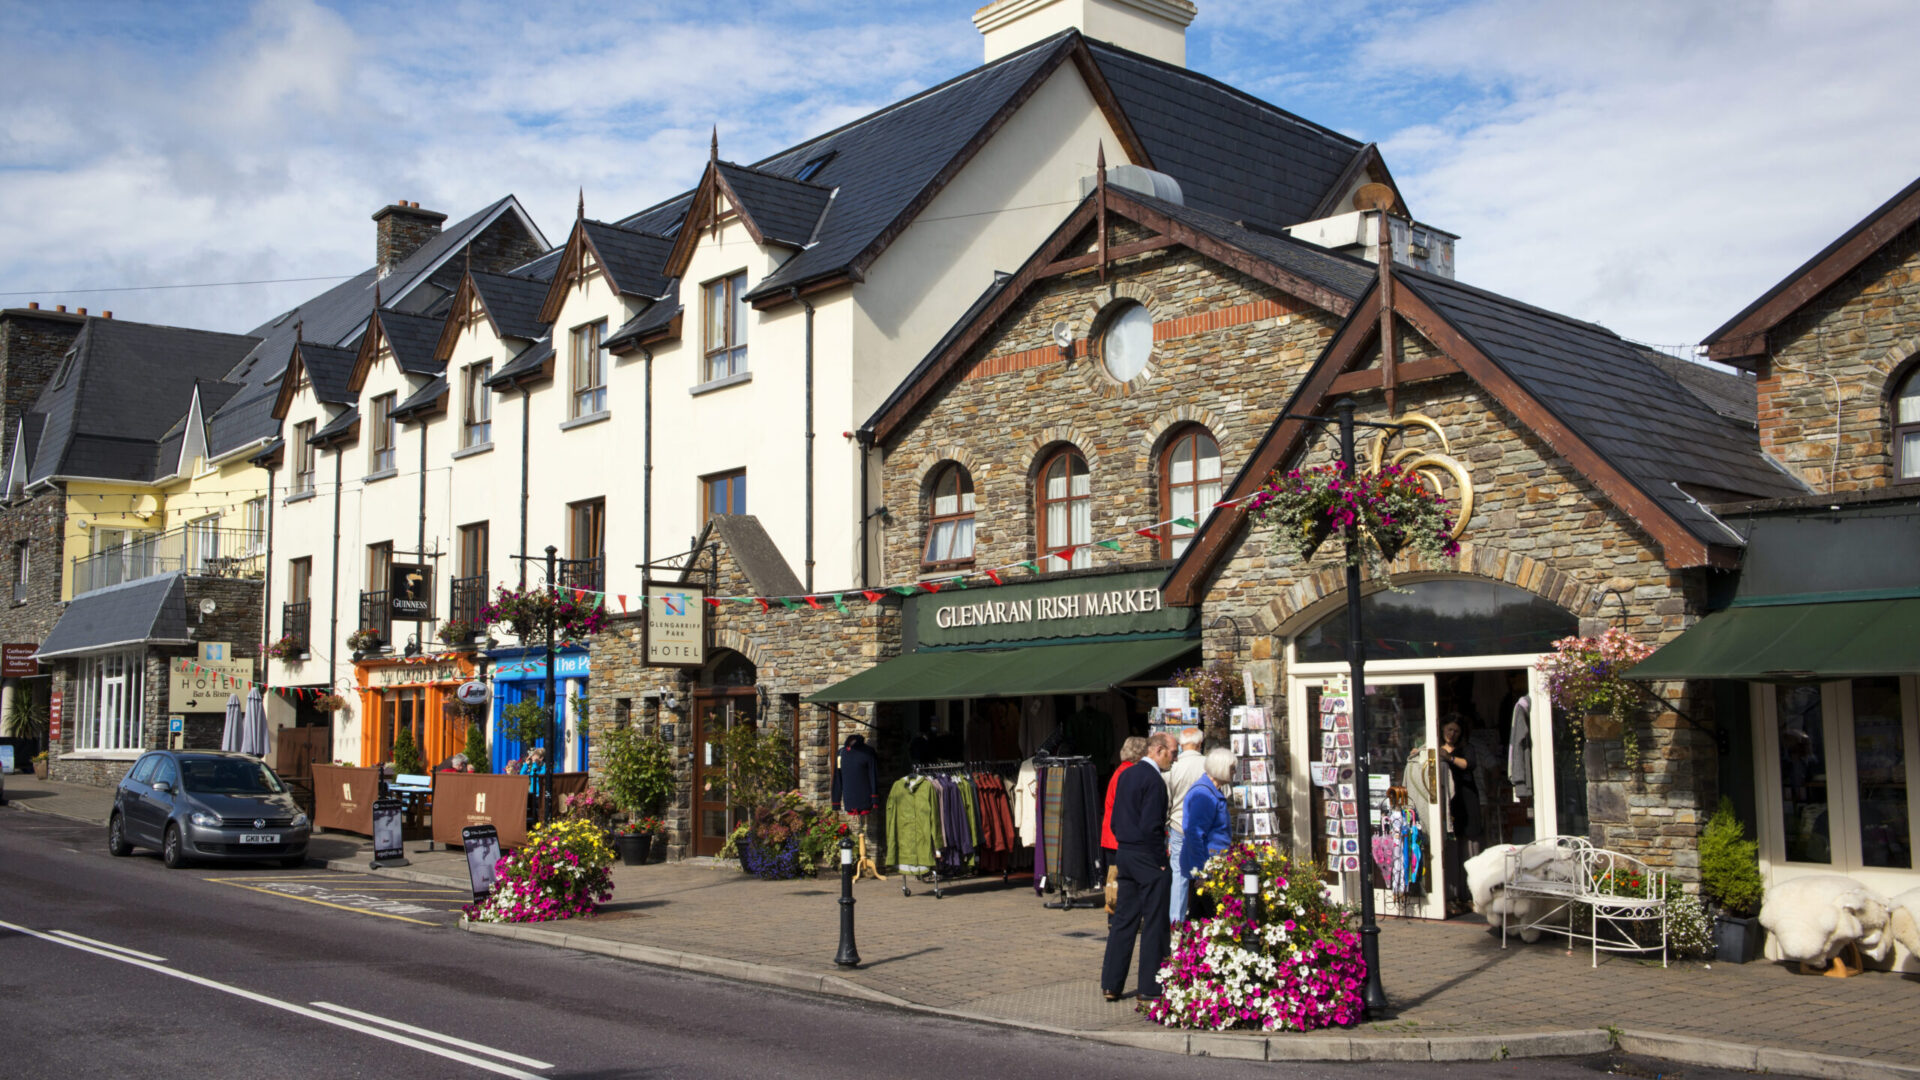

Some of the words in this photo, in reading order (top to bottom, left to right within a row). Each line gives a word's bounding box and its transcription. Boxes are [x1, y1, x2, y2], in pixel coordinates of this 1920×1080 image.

[393, 598, 428, 609] GUINNESS
[936, 600, 1032, 629] GLENARAN
[1037, 595, 1080, 620] IRISH
[1085, 588, 1162, 616] MARKET
[649, 621, 700, 629] GLENGARRIFF
[651, 646, 699, 657] HOTEL
[556, 657, 575, 672] The
[182, 679, 241, 690] HOTEL
[172, 721, 180, 730] P
